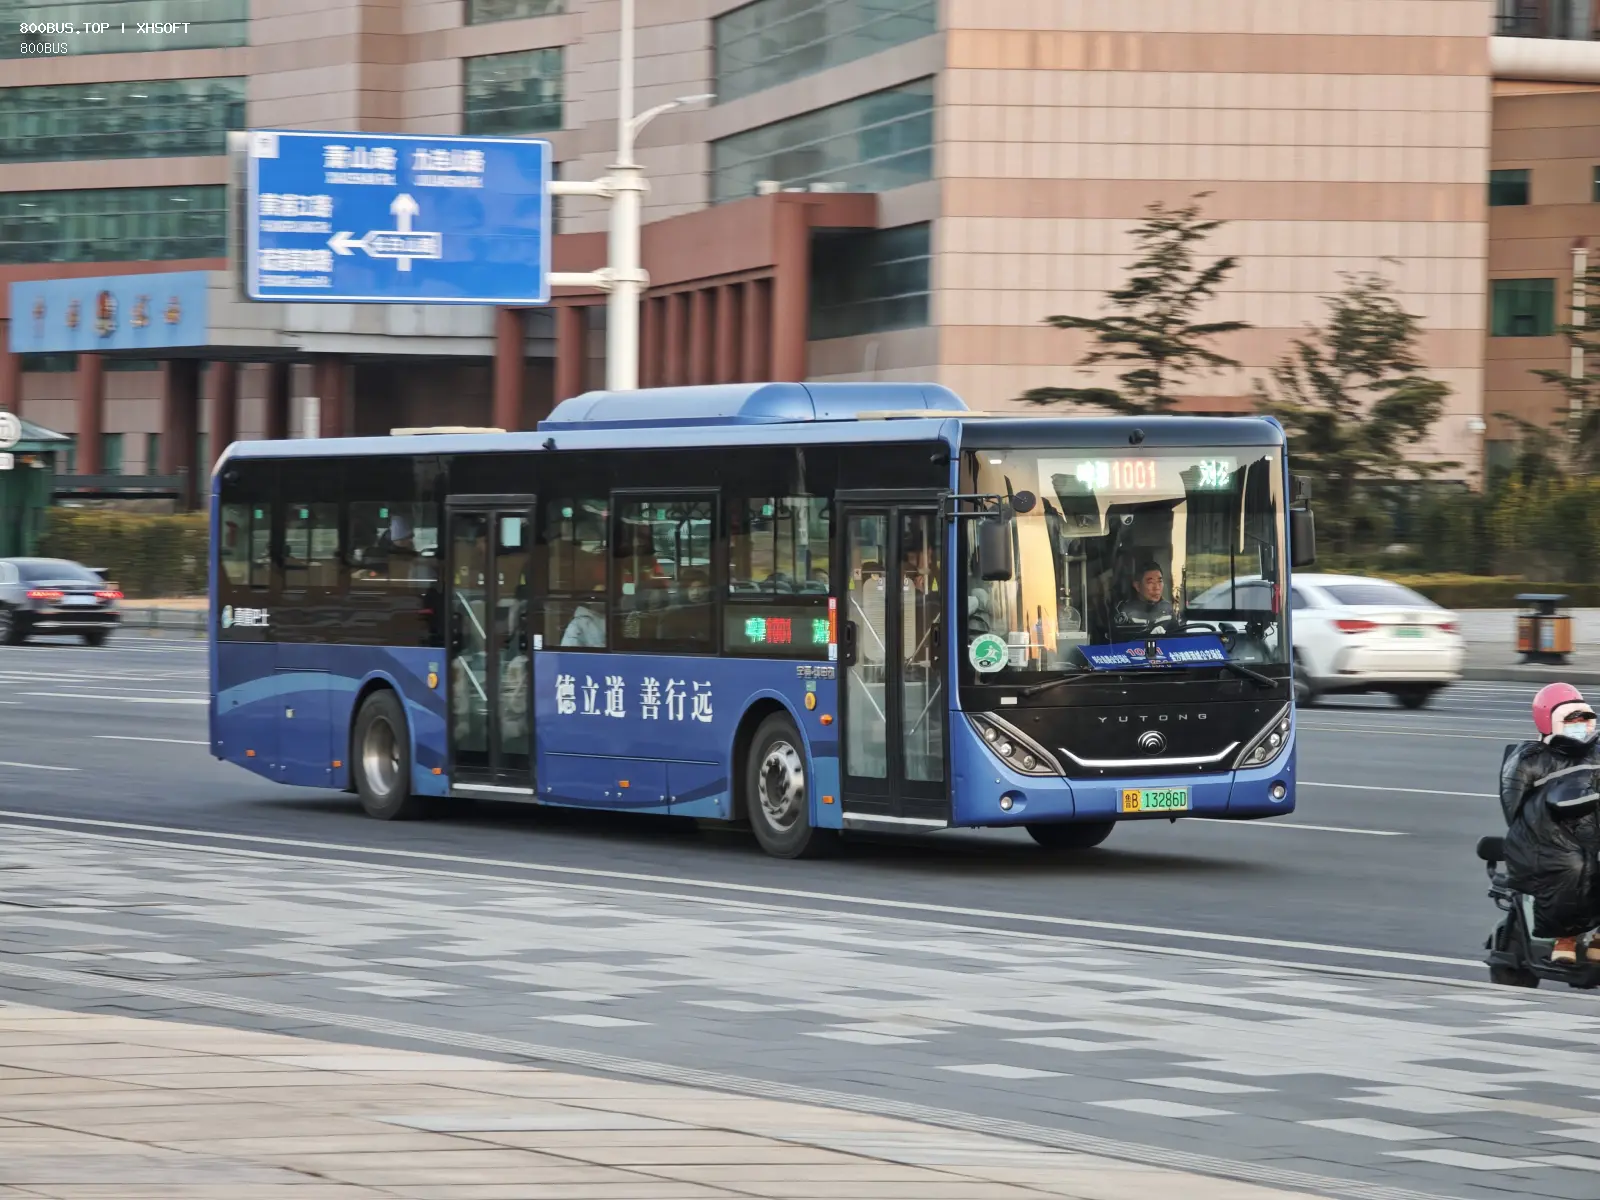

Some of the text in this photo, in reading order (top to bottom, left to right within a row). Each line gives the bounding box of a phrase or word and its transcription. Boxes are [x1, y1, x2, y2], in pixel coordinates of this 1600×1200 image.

[1111, 460, 1156, 489] 1001
[1126, 647, 1163, 657] 101
[555, 674, 714, 723] 德立道 善行远
[1098, 713, 1207, 723] YUTONG
